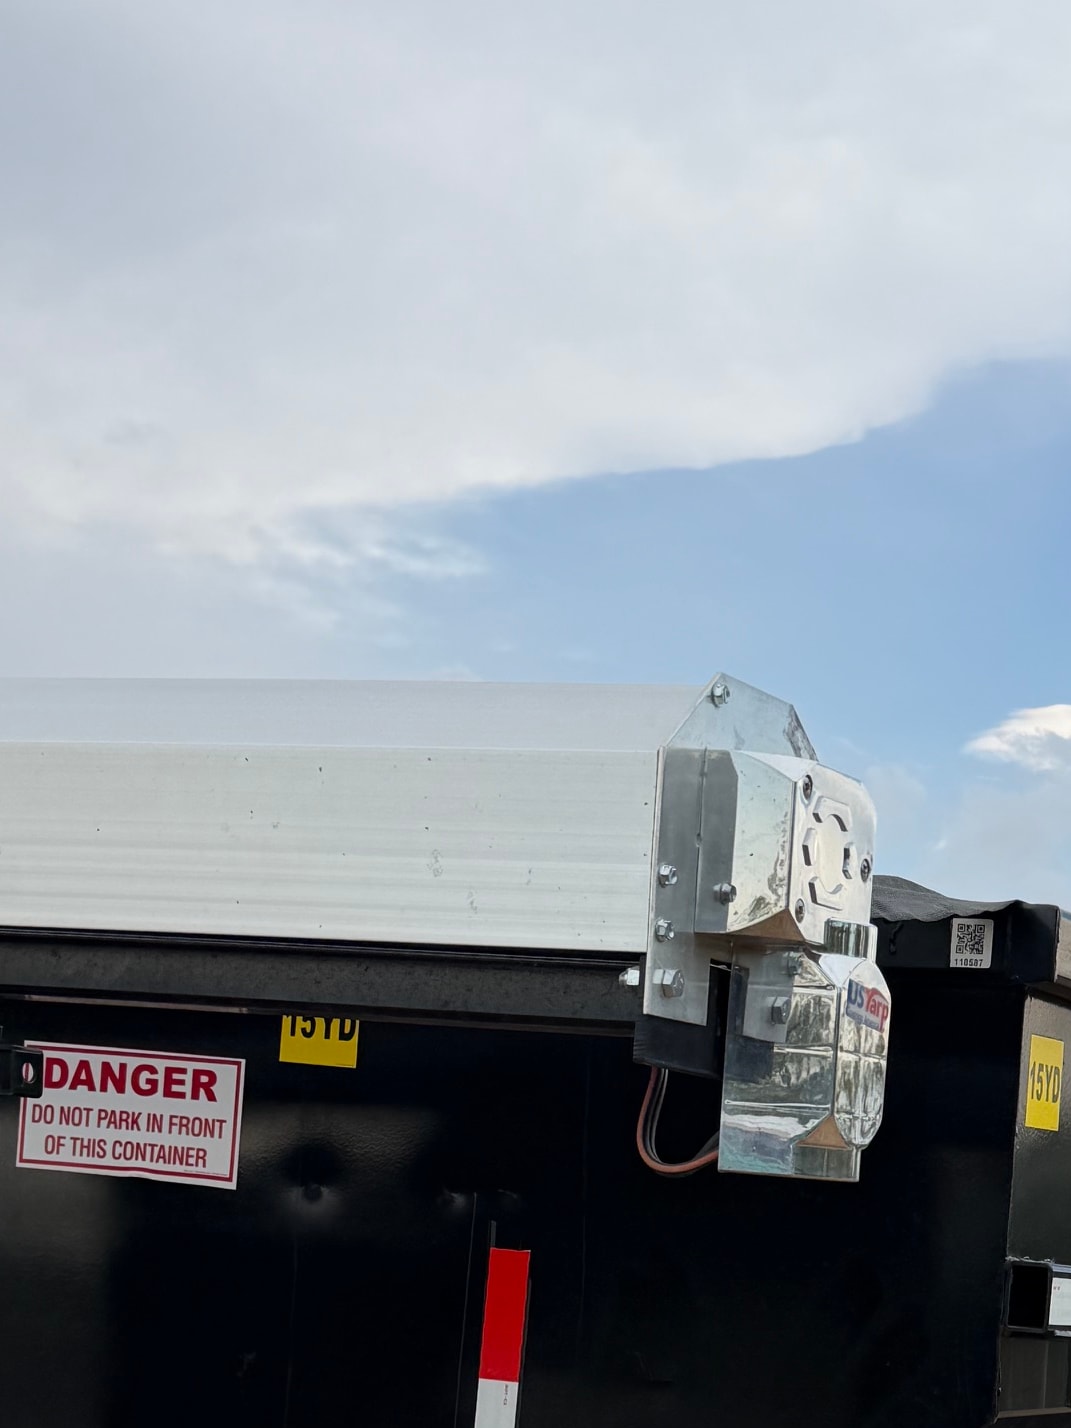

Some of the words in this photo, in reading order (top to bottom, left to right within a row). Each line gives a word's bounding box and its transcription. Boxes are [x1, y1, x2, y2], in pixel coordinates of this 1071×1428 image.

[285, 1015, 358, 1042] 15YD
[44, 1057, 218, 1103] DANGER
[1030, 1061, 1061, 1104] 15YD
[31, 1103, 55, 1125] DO
[59, 1106, 91, 1127] NOT
[97, 1108, 141, 1131] PARK
[146, 1112, 163, 1133] IN
[168, 1115, 227, 1139] FRONT
[44, 1135, 66, 1155] OF
[70, 1137, 107, 1159] THIS
[111, 1140, 208, 1168] CONTAINER
